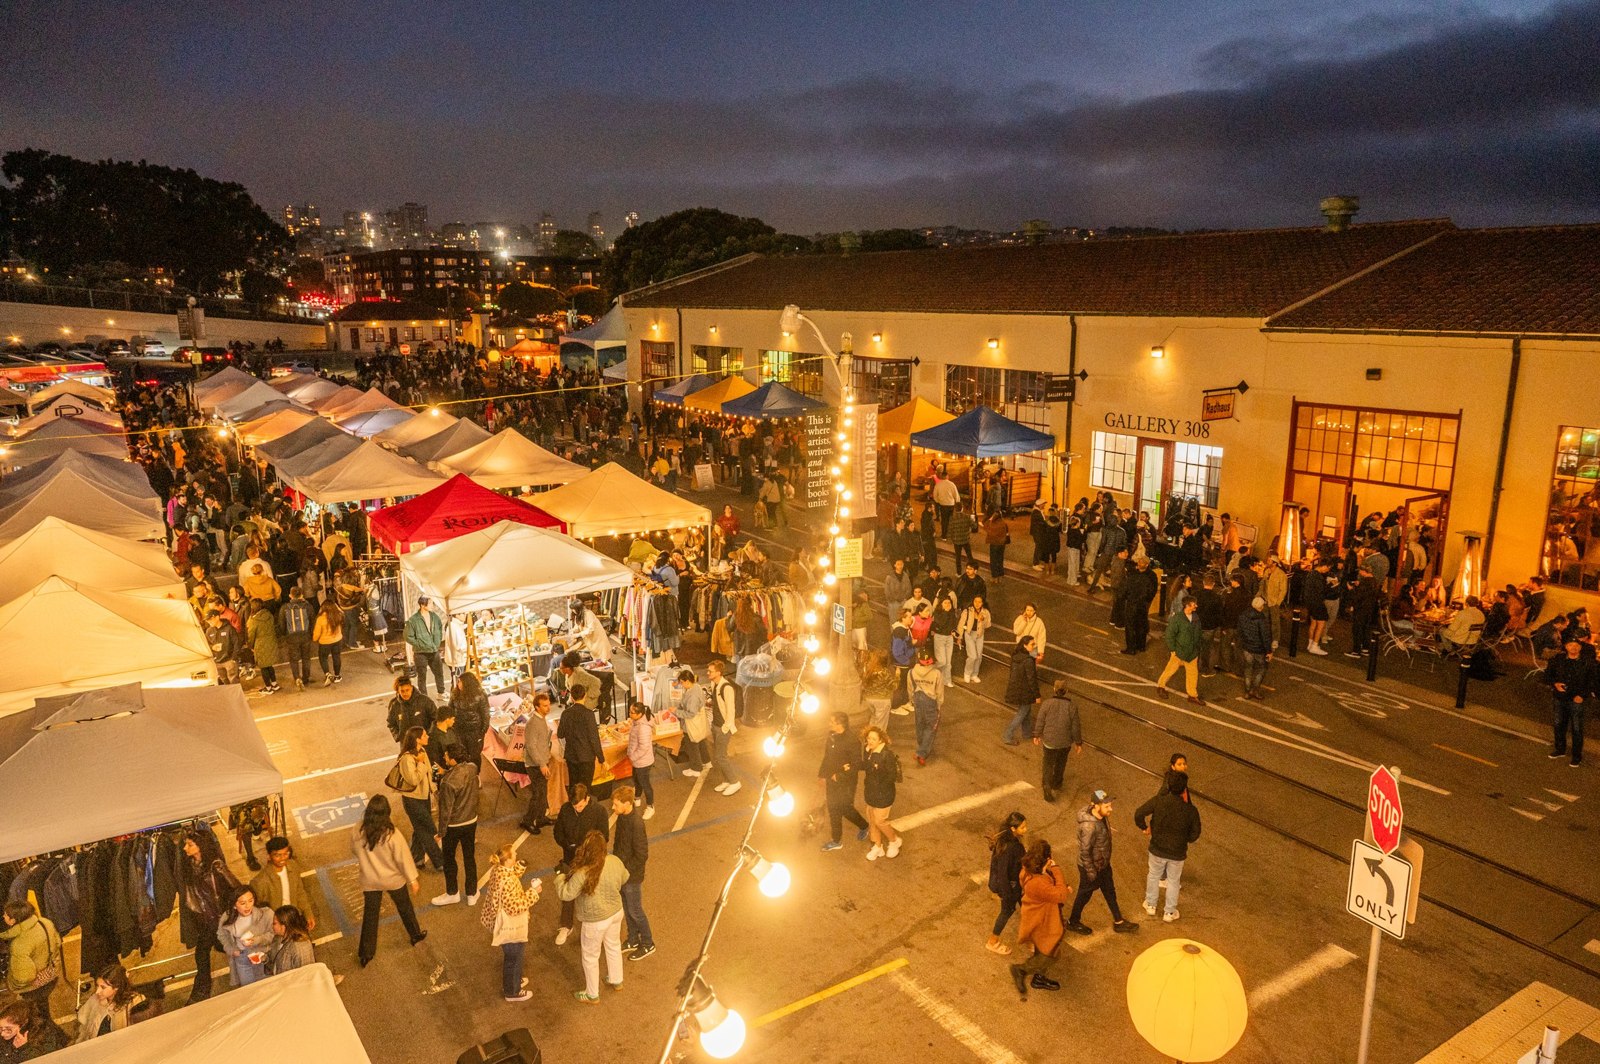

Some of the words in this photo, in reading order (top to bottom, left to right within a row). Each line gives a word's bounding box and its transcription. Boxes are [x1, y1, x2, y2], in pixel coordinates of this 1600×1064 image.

[1206, 400, 1230, 413] Radhaus
[807, 415, 824, 425] This
[825, 415, 832, 424] is
[1104, 412, 1181, 435] GALLERY
[1184, 421, 1210, 439] 308
[808, 426, 830, 436] where
[865, 412, 877, 455] PRESS
[808, 457, 823, 467] and
[808, 477, 832, 488] crafted
[864, 460, 876, 501] ARION
[808, 488, 830, 498] books
[1371, 784, 1399, 834] STOP
[1355, 894, 1398, 925] ONLY
